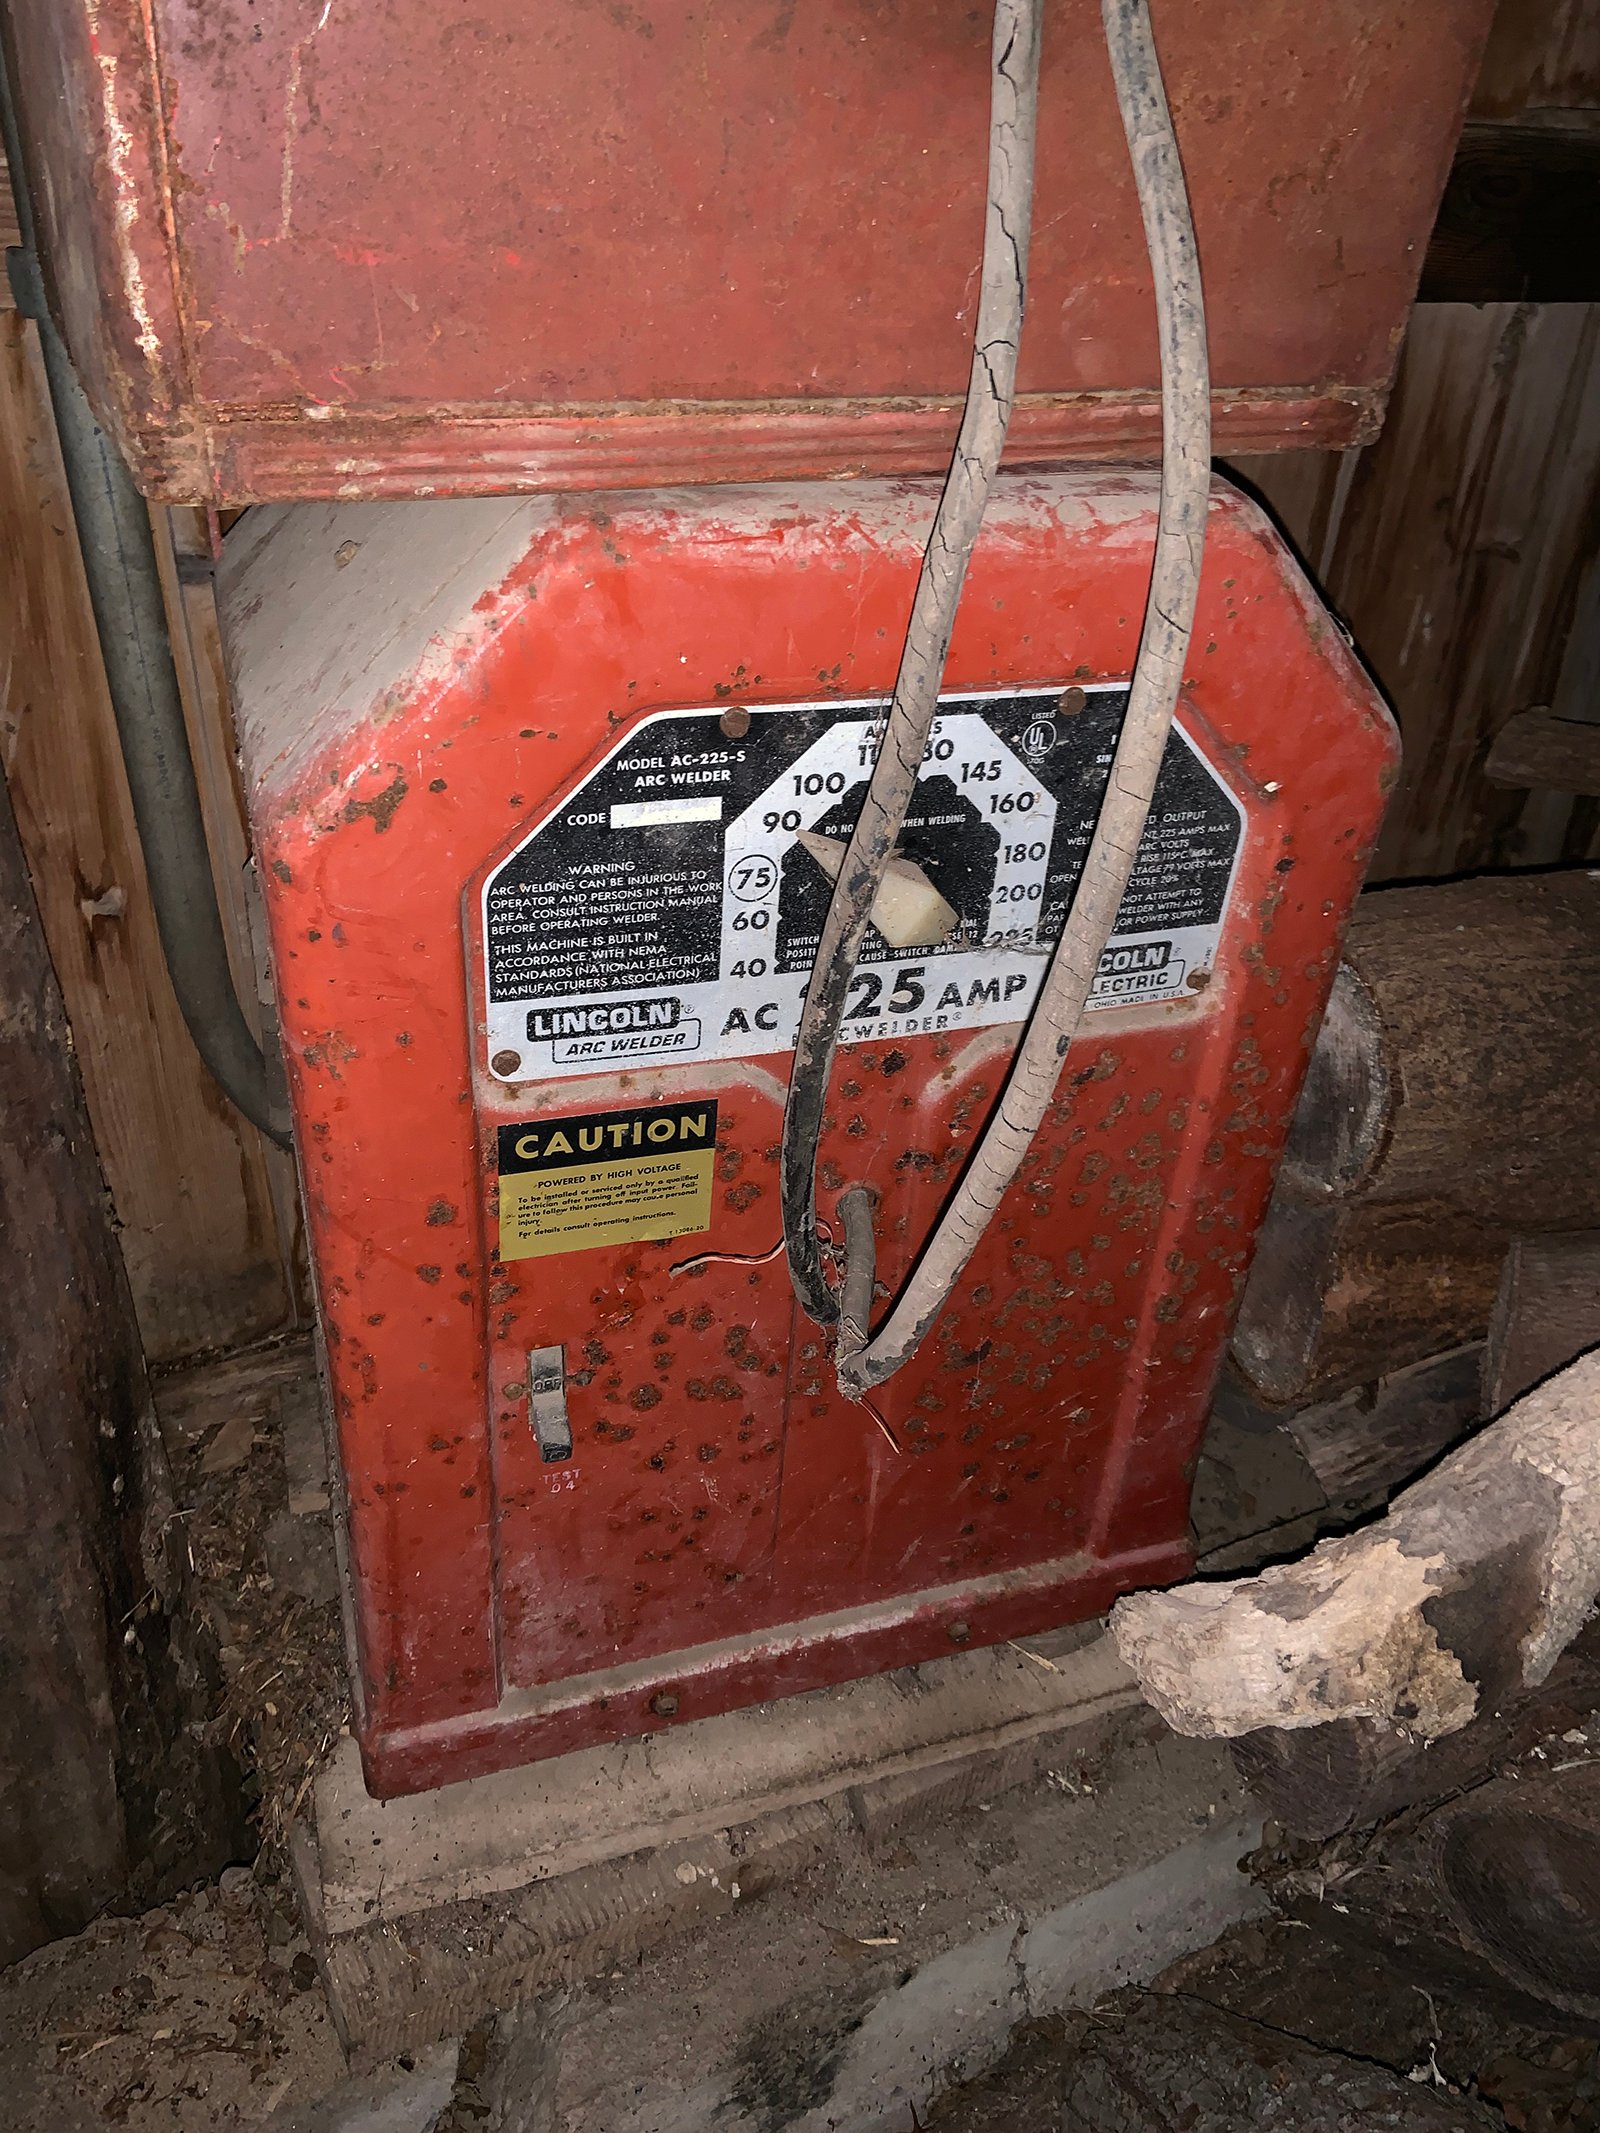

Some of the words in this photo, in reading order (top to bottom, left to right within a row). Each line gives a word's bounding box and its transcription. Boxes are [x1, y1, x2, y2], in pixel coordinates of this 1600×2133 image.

[1031, 711, 1057, 720] LISTED
[617, 757, 665, 771] MODEL
[671, 750, 746, 767] AC-225-S
[961, 760, 1002, 783] 145
[635, 775, 666, 788] ARC
[671, 770, 731, 785] WELDER
[793, 772, 846, 796] 100
[989, 791, 1035, 814] 160
[567, 813, 607, 827] CODE
[762, 810, 802, 833] 90
[825, 825, 837, 835] DO
[840, 824, 854, 834] NO
[928, 814, 966, 826] WELDING
[1163, 810, 1207, 823] OUTPUT
[1160, 828, 1176, 838] 225
[1178, 825, 1206, 836] AMPS
[1003, 842, 1046, 865] 180
[1138, 842, 1157, 852] ARC
[1161, 839, 1190, 849] VOLTS
[568, 862, 636, 876] WARNING
[1140, 853, 1160, 863] RISE
[1177, 860, 1206, 871] VOLTS
[490, 884, 515, 897] ARC
[521, 880, 575, 895] WELDING
[579, 878, 606, 890] CAN
[610, 876, 624, 888] BE
[627, 871, 687, 885] INJURIOUS
[691, 870, 707, 881] TO
[736, 867, 771, 891] 75
[1128, 876, 1158, 887] CYCLE
[490, 896, 555, 910] OPERATOR
[560, 894, 587, 905] AND
[591, 890, 643, 904] PERSONS
[646, 888, 658, 898] IN
[661, 885, 684, 896] THE
[688, 881, 723, 893] WORK
[995, 883, 1042, 904] 200
[1121, 894, 1144, 904] NOT
[1145, 889, 1187, 901] ATTEMPT
[1189, 887, 1202, 897] TO
[490, 912, 528, 923] AREA.
[532, 906, 585, 919] CONSULT
[589, 900, 665, 915] INSTRUCTION
[668, 895, 717, 907] MANUAL
[1118, 904, 1155, 915] WELDER
[1157, 901, 1181, 911] WITH
[1182, 898, 1204, 908] ANY
[491, 924, 536, 936] BEFORE
[540, 916, 608, 931] OPERATING
[612, 913, 660, 925] WELDER.
[732, 910, 770, 931] 60
[1135, 913, 1170, 924] POWER
[494, 944, 522, 956] THIS
[526, 938, 588, 953] MACHINE
[592, 937, 605, 947] IS
[608, 933, 641, 946] BUILT
[645, 932, 659, 943] IN
[787, 935, 820, 947] SWITCH
[494, 952, 586, 970] ACCORDANCE
[592, 948, 625, 960] WITH
[628, 945, 667, 957] NEMA
[893, 948, 928, 958] SWITCH
[1098, 945, 1166, 973] COLN
[495, 967, 573, 984] STANDARDS
[574, 959, 647, 977] (NATIONAL
[649, 953, 718, 970] ELECTRICAL
[730, 958, 767, 979] 40
[496, 977, 608, 997] MANUFACTURERS
[611, 967, 700, 985] ASSOCIATION)
[720, 1002, 779, 1036] AC
[935, 973, 1028, 1012] AMP
[1094, 1000, 1117, 1009] OHIO
[1149, 993, 1159, 1001] IN
[534, 1002, 673, 1036] LINCOLN
[565, 1040, 606, 1057] ARC
[610, 1032, 687, 1053] WELDER
[515, 1113, 708, 1160] CAUTION
[537, 1175, 587, 1190] POWERED
[590, 1173, 603, 1183] BY
[607, 1169, 633, 1180] HIGH
[637, 1163, 681, 1176] VOLTAGE
[544, 1190, 578, 1201] installed
[592, 1184, 623, 1194] serviced
[625, 1181, 643, 1191] only
[645, 1180, 656, 1188] by
[666, 1173, 699, 1185] qualified
[518, 1200, 559, 1211] electrician
[561, 1197, 581, 1206] after
[584, 1193, 612, 1204] turning
[615, 1190, 626, 1198] off
[629, 1188, 649, 1198] input
[681, 1182, 698, 1190] Fail-
[542, 1206, 568, 1216] follow
[569, 1202, 583, 1212] this
[584, 1198, 624, 1211] procedure
[625, 1197, 642, 1205] may
[665, 1188, 698, 1200] personal
[518, 1218, 542, 1227] injury.
[518, 1230, 531, 1239] For
[534, 1226, 561, 1236] details
[563, 1221, 591, 1232] consult
[592, 1217, 630, 1228] operating
[632, 1210, 677, 1222] instructions.
[542, 1468, 582, 1485] TEST
